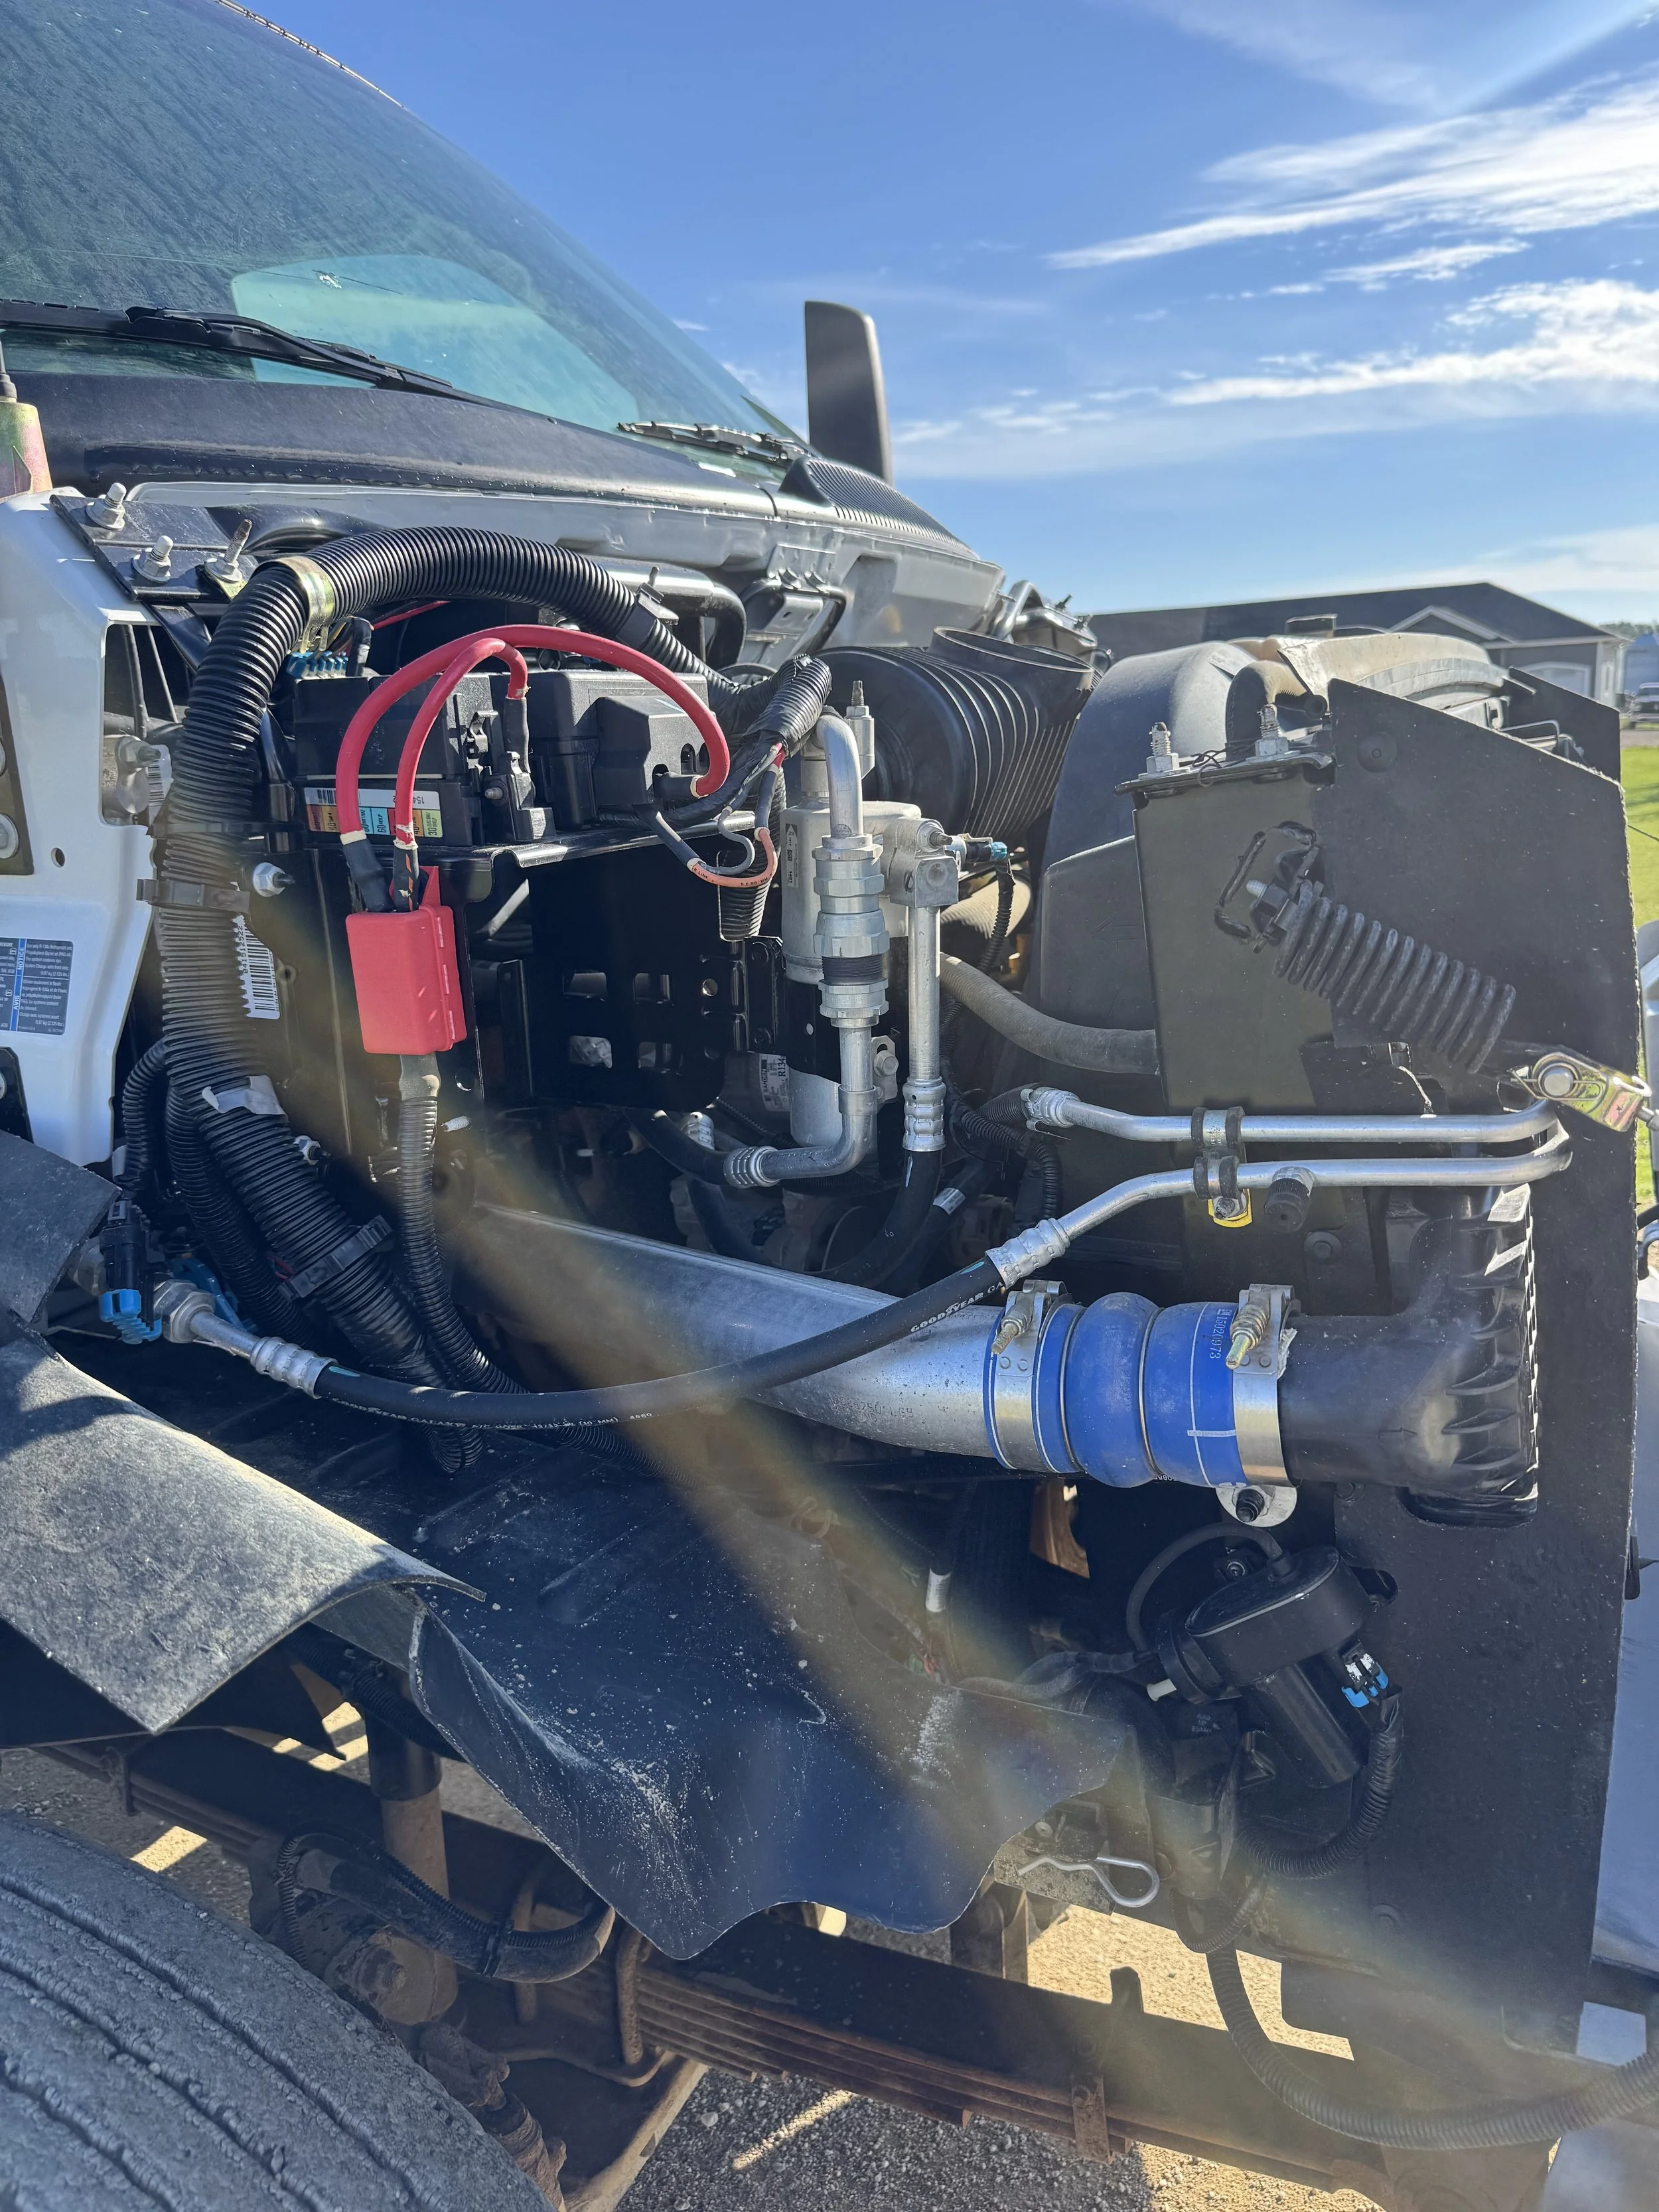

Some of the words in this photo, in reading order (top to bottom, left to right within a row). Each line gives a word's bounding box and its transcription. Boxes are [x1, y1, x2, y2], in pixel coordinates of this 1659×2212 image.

[377, 824, 387, 833] 60
[427, 827, 438, 836] 30
[910, 1291, 984, 1333] GOODYEAR
[1209, 1316, 1228, 1359] 15020973
[332, 1397, 407, 1420] GOODYEAR
[411, 1417, 466, 1428] GALAXY
